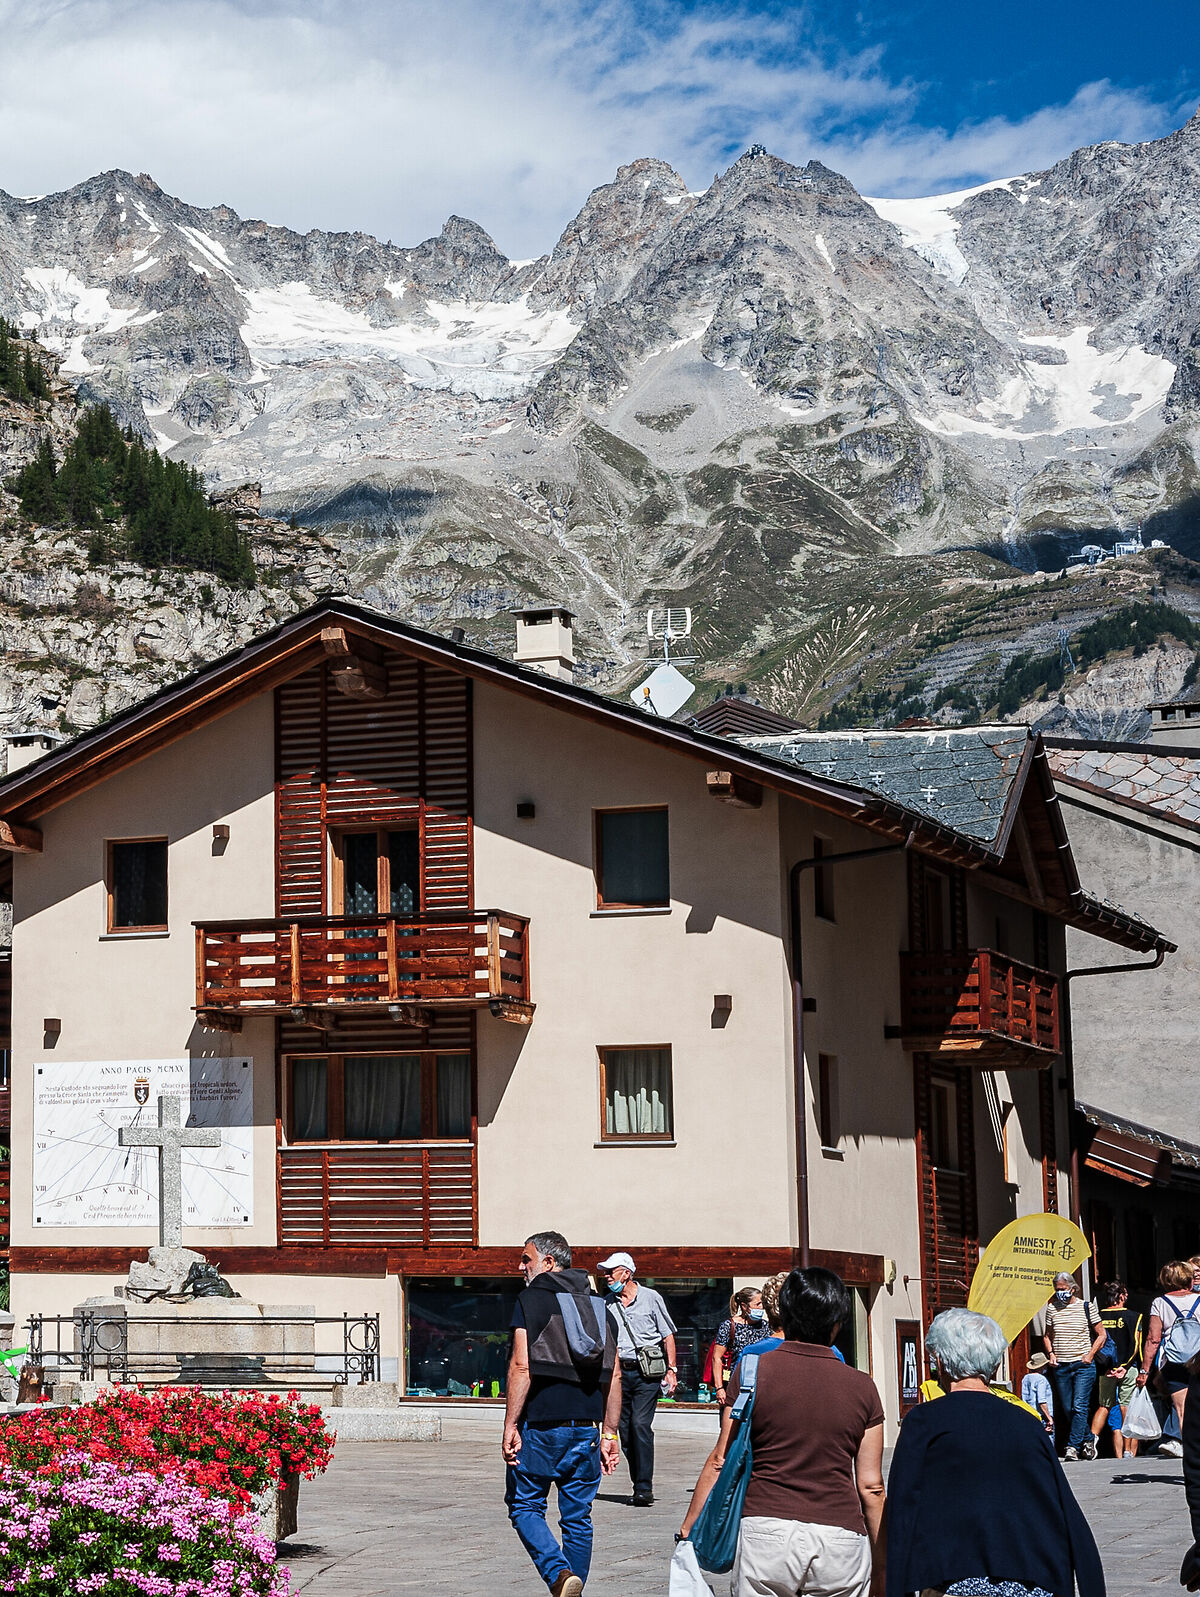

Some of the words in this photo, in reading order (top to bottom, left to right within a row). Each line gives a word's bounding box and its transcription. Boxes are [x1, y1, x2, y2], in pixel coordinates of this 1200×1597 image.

[101, 1067, 122, 1075] ANNO
[126, 1066, 152, 1074] PACIS
[157, 1065, 184, 1073] MCMXX
[1013, 1236, 1056, 1249] AMNESTY
[1012, 1247, 1055, 1257] INTERNATIONAL
